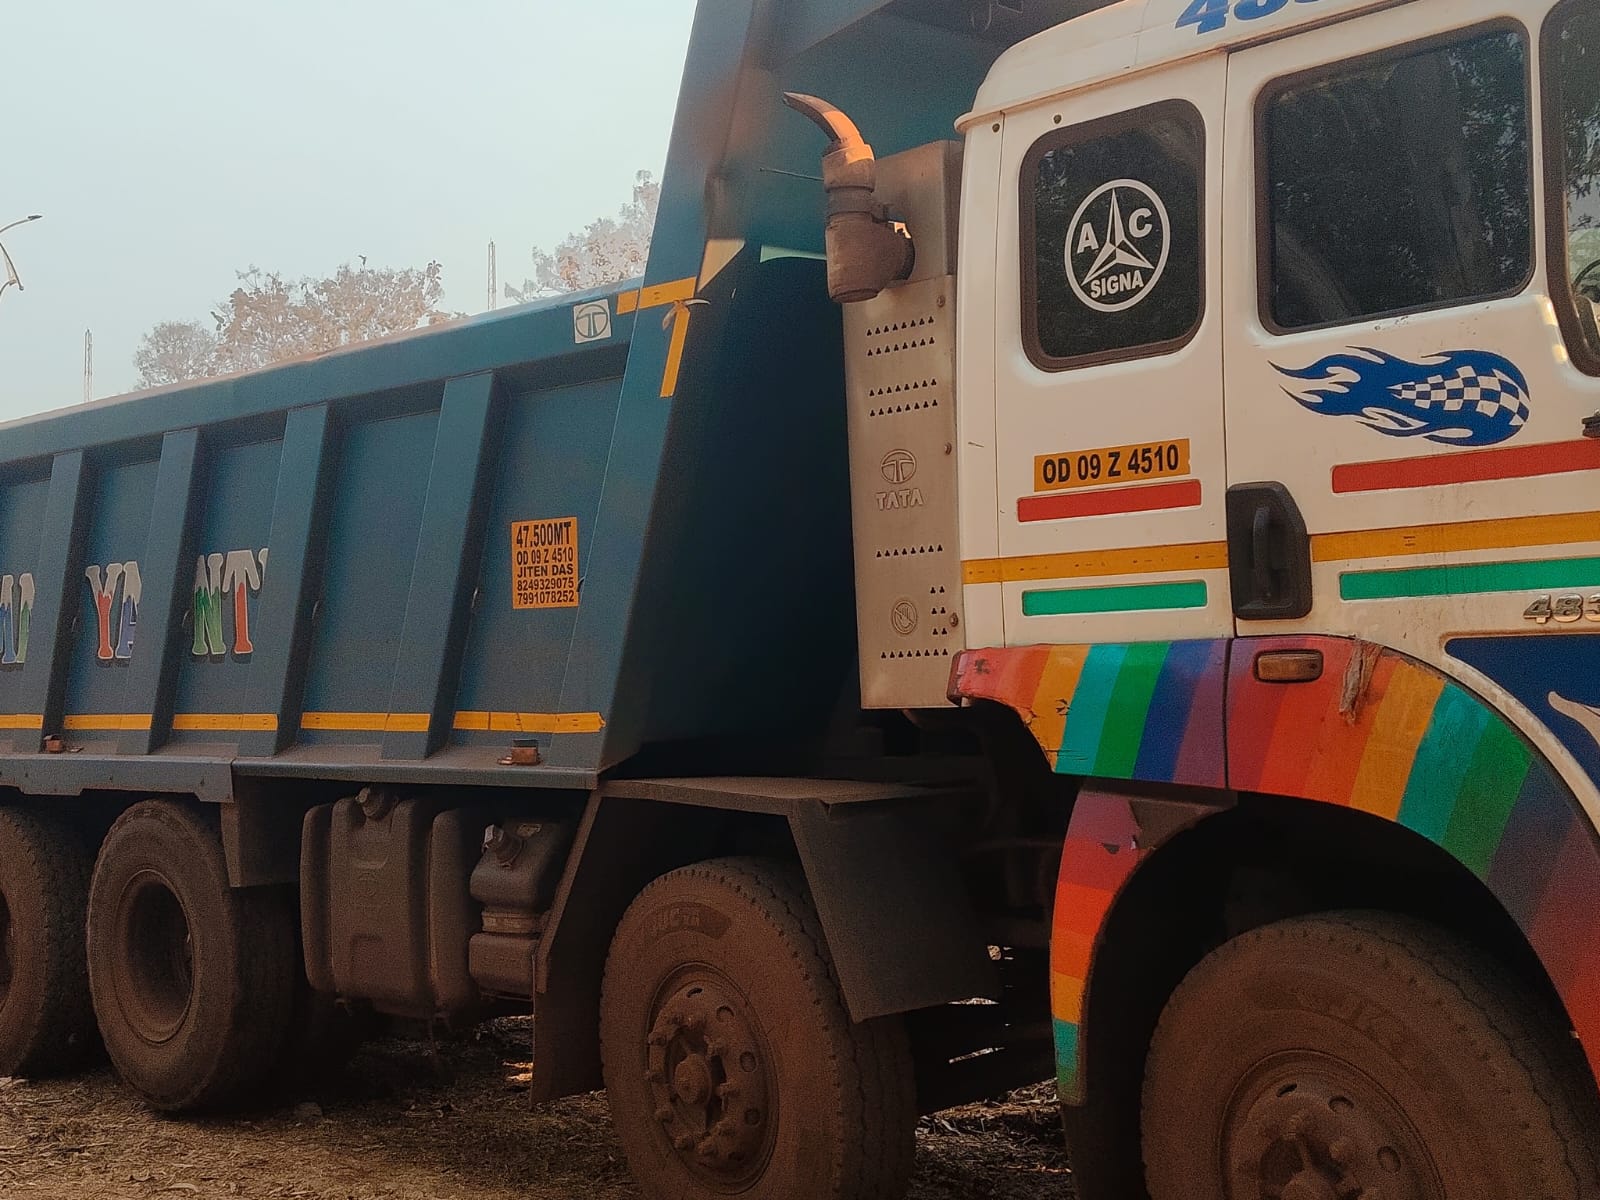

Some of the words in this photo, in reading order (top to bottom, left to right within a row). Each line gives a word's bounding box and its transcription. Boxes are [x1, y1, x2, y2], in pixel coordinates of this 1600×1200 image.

[1076, 222, 1099, 254] A
[1128, 207, 1153, 238] C
[1090, 269, 1144, 299] SIGNA
[1042, 458, 1071, 484] OD
[1077, 453, 1101, 480] 09
[1108, 451, 1121, 477] Z
[1127, 444, 1179, 474] 4510
[875, 487, 924, 511] TATA
[516, 521, 572, 548] 47.500MT
[516, 550, 529, 565] OD
[531, 549, 541, 564] 09
[543, 548, 549, 563] Z
[551, 547, 573, 563] 4510
[517, 565, 548, 578] JITEN
[552, 563, 573, 576] DAS
[517, 577, 574, 591] 8249329075
[517, 590, 575, 605] 7991078252
